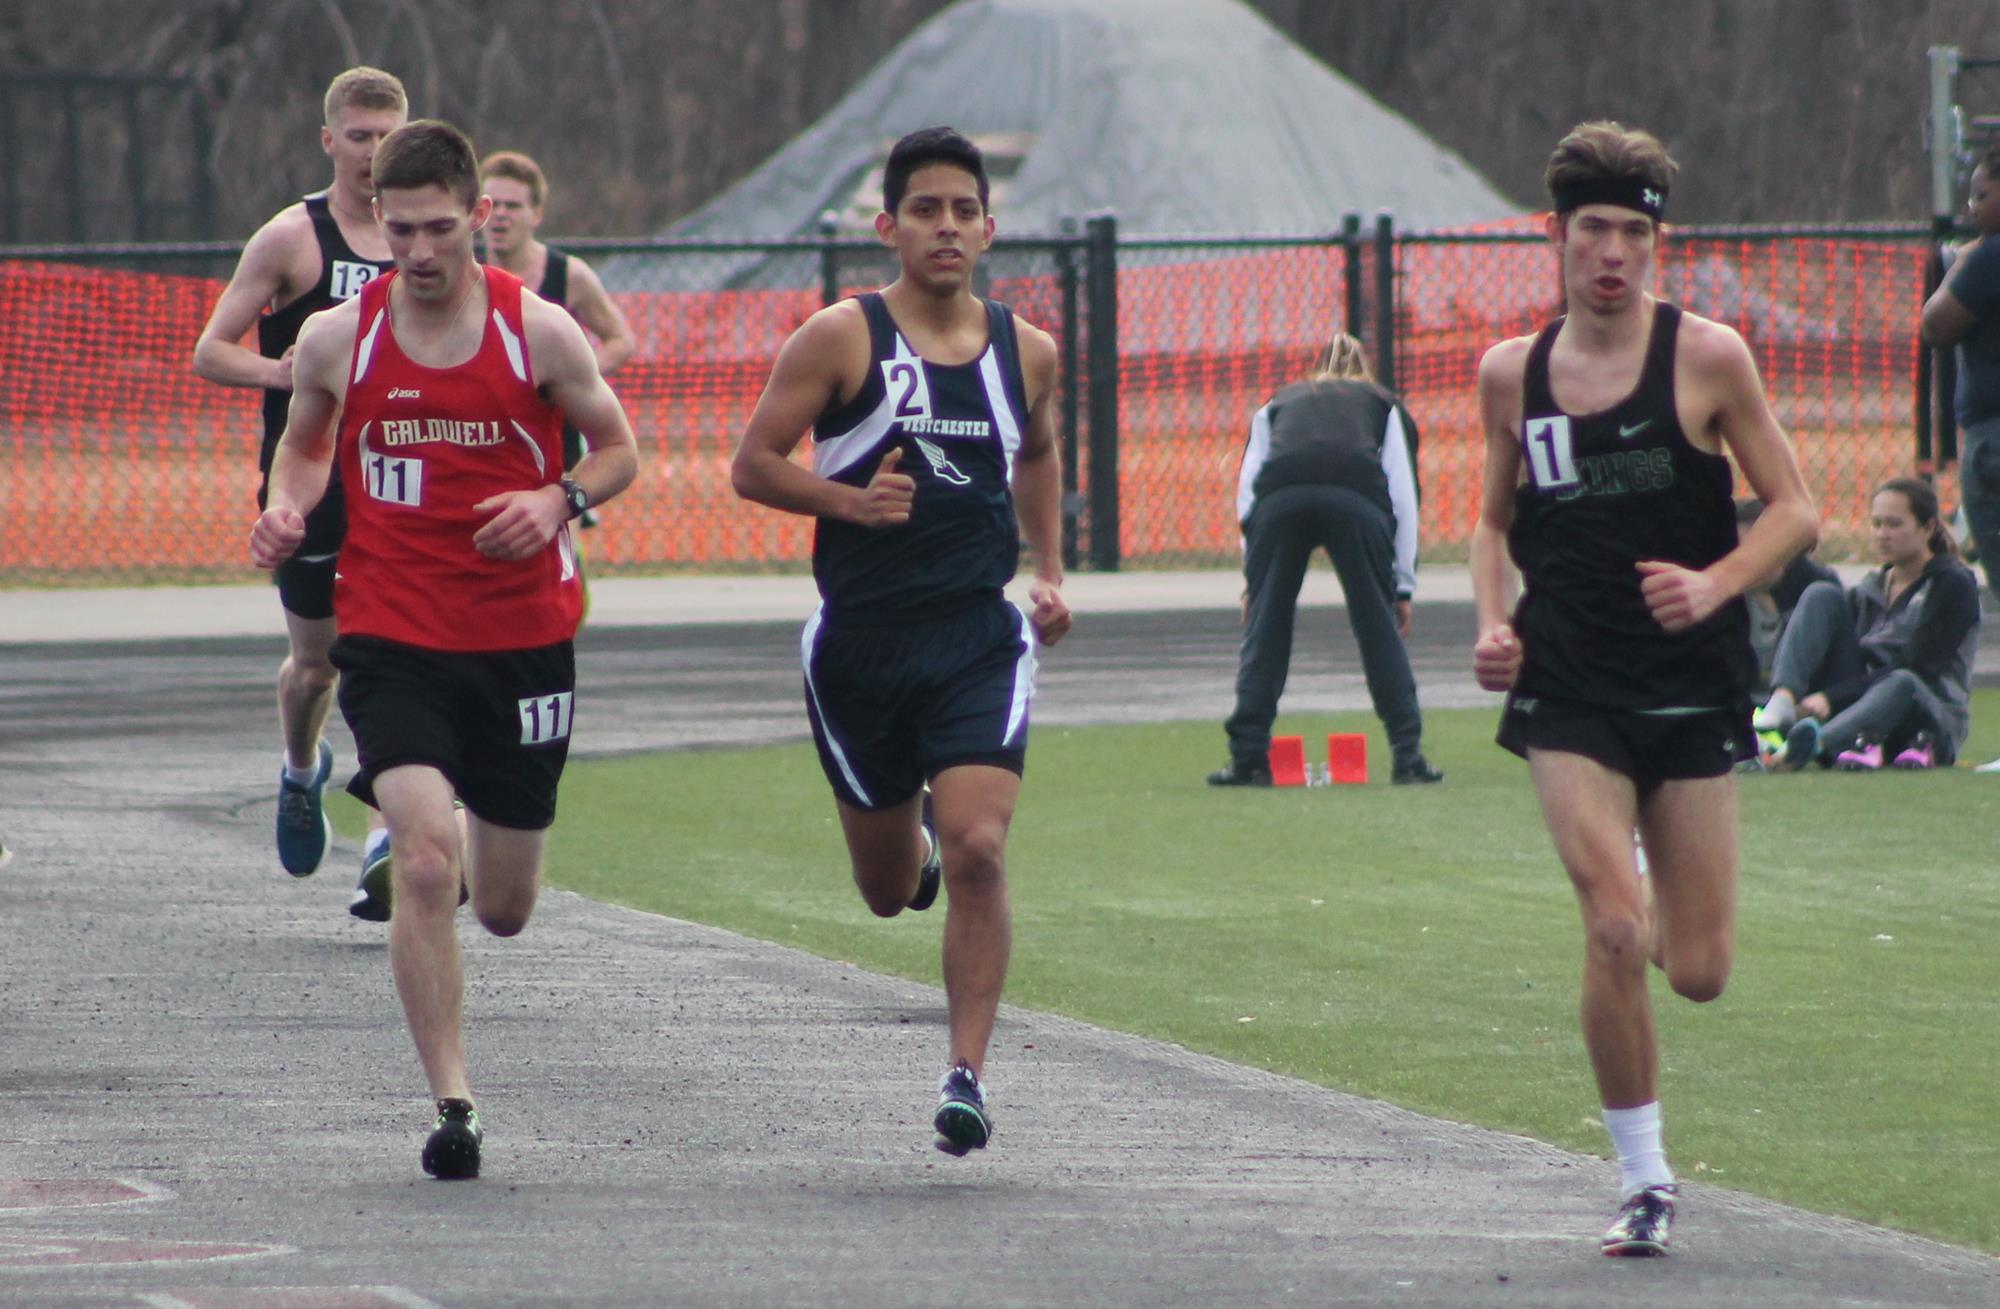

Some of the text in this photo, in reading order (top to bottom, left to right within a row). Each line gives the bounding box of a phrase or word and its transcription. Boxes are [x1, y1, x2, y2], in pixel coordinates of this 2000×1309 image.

[890, 363, 924, 418] 2
[381, 418, 506, 447] CALDWELL
[902, 418, 990, 437] WESTCHESTER
[1534, 422, 1562, 481] 1
[371, 456, 406, 502] 11
[524, 695, 561, 742] 11
